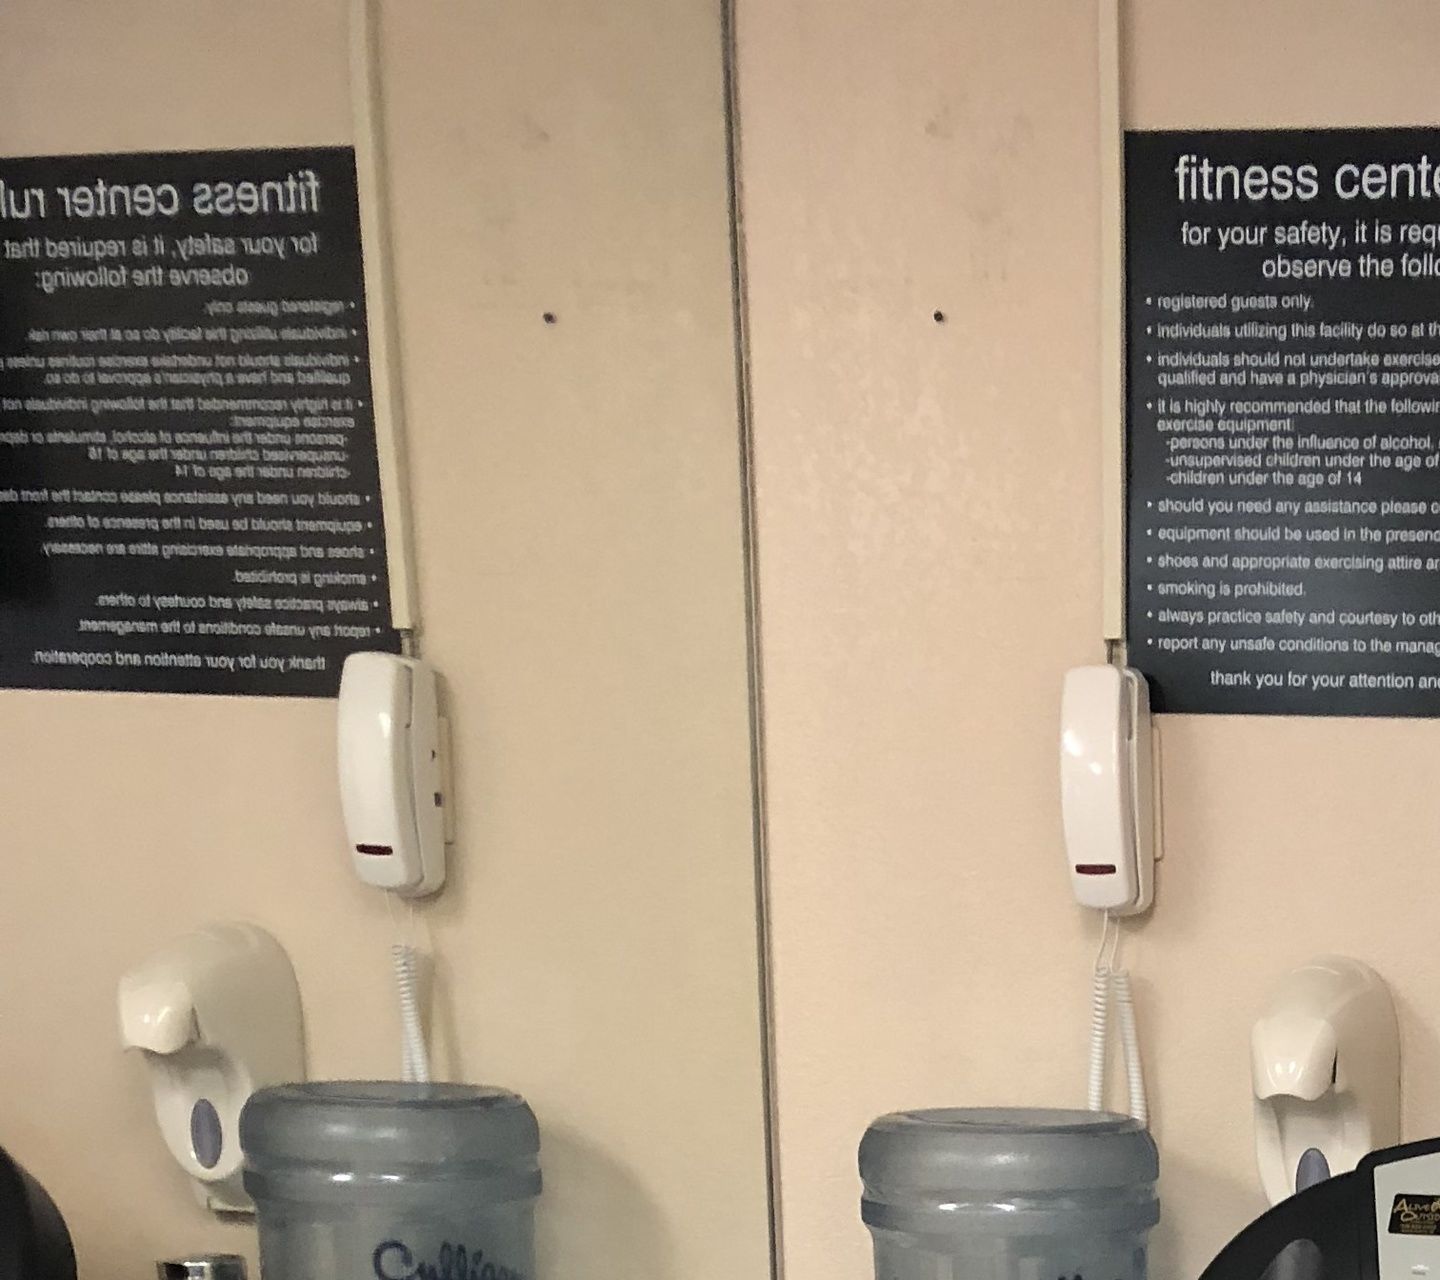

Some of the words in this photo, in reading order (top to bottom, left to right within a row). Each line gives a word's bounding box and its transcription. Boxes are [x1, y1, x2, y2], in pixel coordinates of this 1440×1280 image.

[1174, 154, 1319, 201] fitness
[1180, 221, 1211, 245] for
[1217, 226, 1268, 250] your
[1274, 220, 1346, 251] safety,
[1354, 220, 1367, 243] it
[1374, 219, 1392, 243] is
[1261, 254, 1352, 278] observe
[1357, 253, 1394, 277] the
[1157, 293, 1227, 312] registered
[1230, 295, 1278, 312] guests
[1156, 323, 1231, 338] individuals
[1234, 322, 1287, 341] utilizing
[1290, 323, 1316, 337] this
[1319, 321, 1363, 340] facility
[1366, 322, 1386, 338] do
[1389, 324, 1407, 337] so
[1410, 322, 1424, 337] at
[1157, 352, 1230, 366] individuals
[1232, 352, 1280, 366] should
[1283, 352, 1306, 366] not
[1308, 352, 1380, 366] undertake
[1157, 371, 1216, 389] qualified
[1219, 371, 1246, 385] and
[1250, 371, 1284, 385] have
[1286, 373, 1296, 385] a
[1299, 371, 1378, 389] physician's
[1157, 398, 1166, 415] it
[1169, 398, 1181, 415] is
[1184, 398, 1226, 419] highly
[1229, 398, 1331, 415] recommended
[1334, 398, 1361, 415] that
[1363, 398, 1387, 415] the
[1156, 416, 1214, 432] exercise
[1228, 436, 1269, 451] under
[1271, 436, 1294, 451] the
[1295, 436, 1359, 451] influence
[1362, 436, 1377, 451] of
[1265, 453, 1321, 468] children
[1324, 453, 1365, 468] under
[1368, 453, 1391, 468] the
[1394, 455, 1421, 473] age
[1424, 453, 1440, 468] of
[1228, 471, 1269, 486] under
[1271, 471, 1294, 486] the
[1297, 473, 1324, 490] age
[1327, 471, 1342, 486] of
[1346, 471, 1362, 486] 14
[1157, 497, 1204, 512] should
[1207, 501, 1233, 515] you
[1236, 498, 1272, 513] need
[1274, 501, 1301, 516] any
[1304, 500, 1377, 513] assistance
[1380, 500, 1427, 516] please
[1157, 527, 1230, 542] equipment
[1234, 526, 1280, 541] should
[1284, 527, 1302, 541] be
[1305, 527, 1340, 541] used
[1343, 528, 1356, 540] in
[1359, 527, 1382, 541] the
[1157, 554, 1199, 568] shoes
[1201, 554, 1228, 568] and
[1231, 555, 1310, 571] appropriate
[1314, 555, 1384, 573] exercising
[1387, 556, 1422, 570] attire
[1157, 581, 1216, 599] smoking
[1219, 581, 1231, 596] is
[1157, 608, 1204, 625] always
[1207, 609, 1262, 625] practice
[1264, 608, 1305, 626] safety
[1308, 609, 1335, 624] and
[1338, 611, 1398, 628] courtesy
[1401, 612, 1416, 625] to
[1157, 636, 1198, 652] report
[1201, 638, 1227, 653] any
[1229, 635, 1275, 651] unsafe
[1278, 637, 1349, 652] conditions
[1352, 639, 1367, 652] to
[1369, 638, 1392, 652] the
[1210, 670, 1251, 685] thank
[1255, 673, 1283, 690] you
[1287, 671, 1308, 686] for
[1311, 674, 1345, 691] your
[1348, 673, 1414, 688] attention
